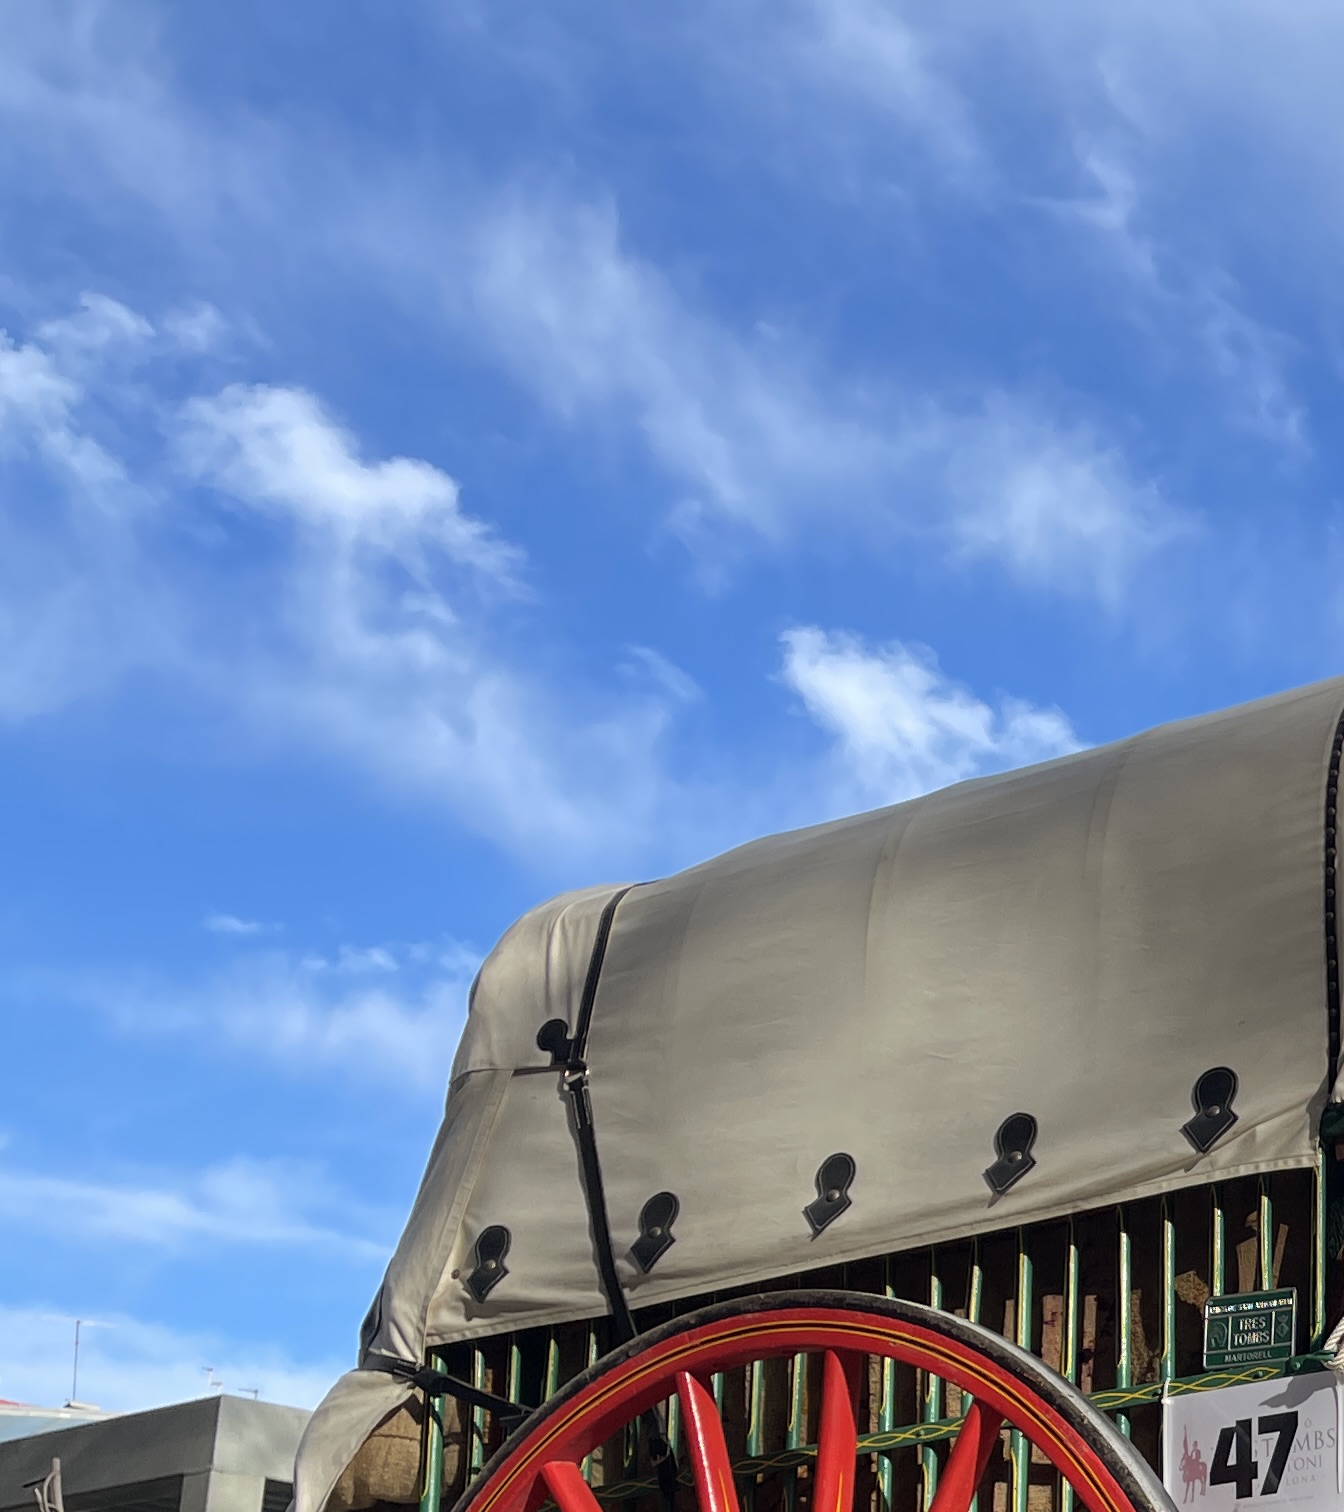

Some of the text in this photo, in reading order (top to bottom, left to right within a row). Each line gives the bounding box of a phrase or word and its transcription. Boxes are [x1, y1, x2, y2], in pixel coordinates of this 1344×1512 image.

[1238, 1316, 1267, 1331] TRES
[1233, 1330, 1270, 1346] TOMBS
[1224, 1350, 1273, 1362] MARTORELL
[1260, 1428, 1336, 1458] TMBS
[1209, 1410, 1299, 1500] 47
